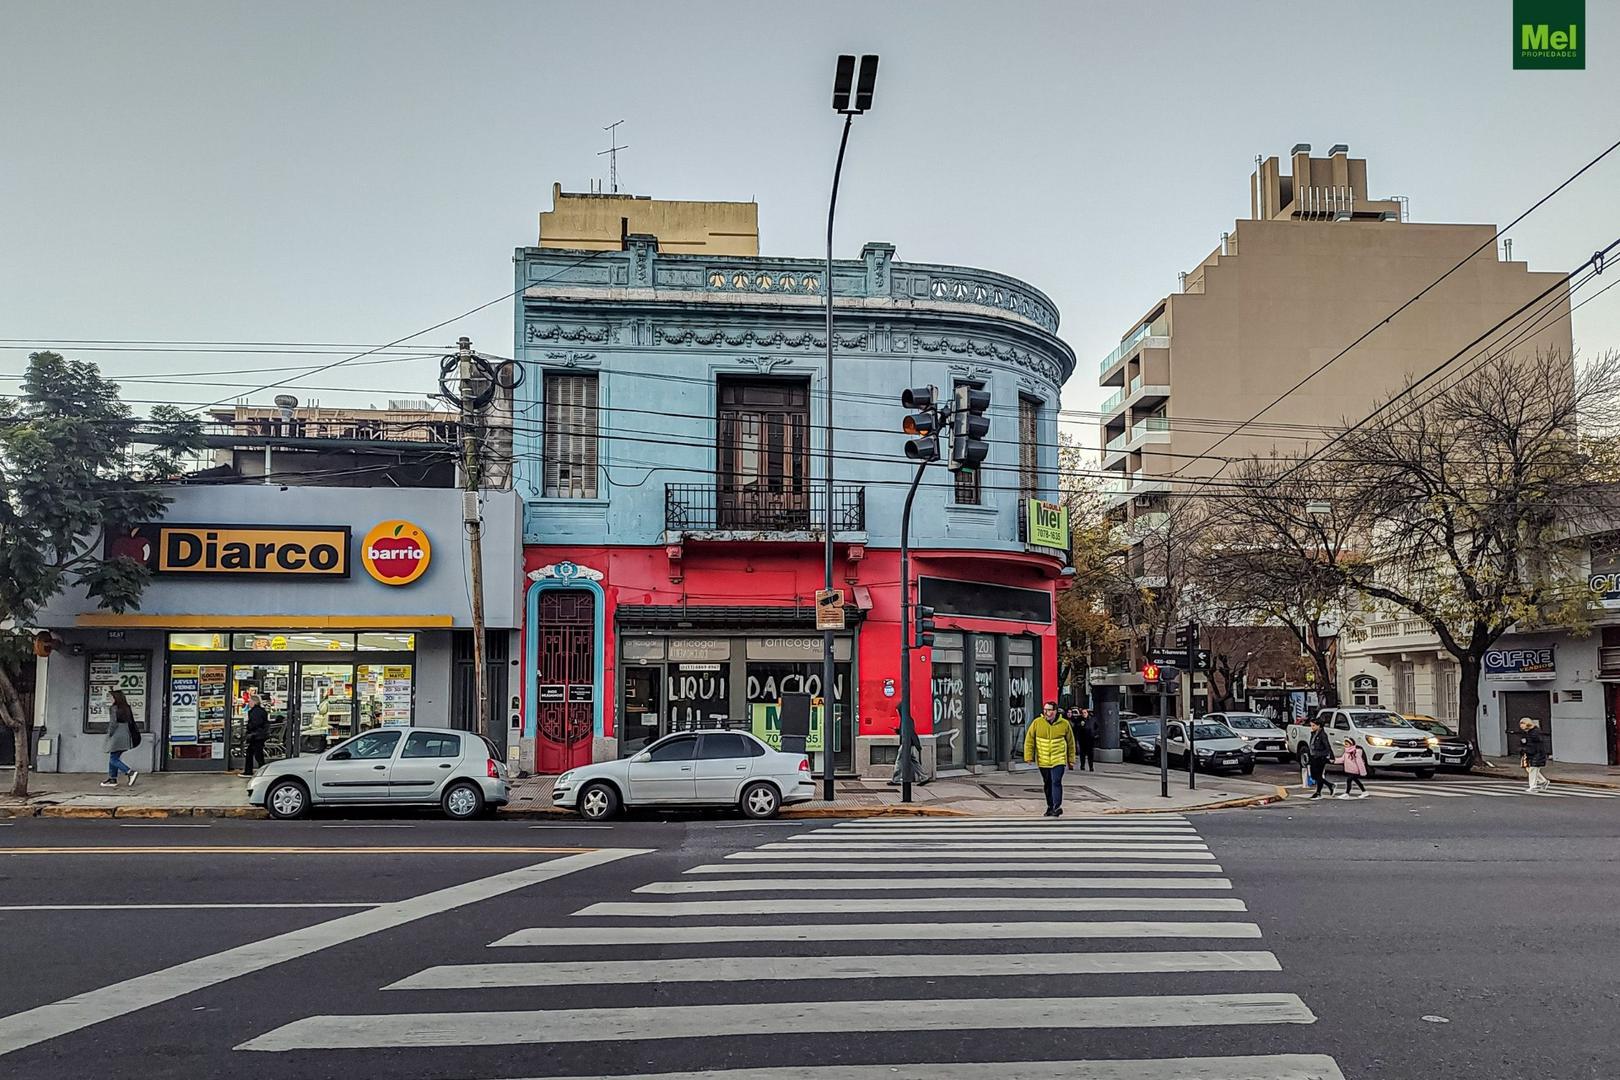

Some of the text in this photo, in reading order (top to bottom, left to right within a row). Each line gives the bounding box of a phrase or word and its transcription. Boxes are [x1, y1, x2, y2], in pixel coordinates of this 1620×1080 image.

[1036, 502, 1060, 529] Mel
[166, 532, 340, 571] Diarco
[368, 546, 424, 560] barrio
[1486, 650, 1551, 667] CIFRE
